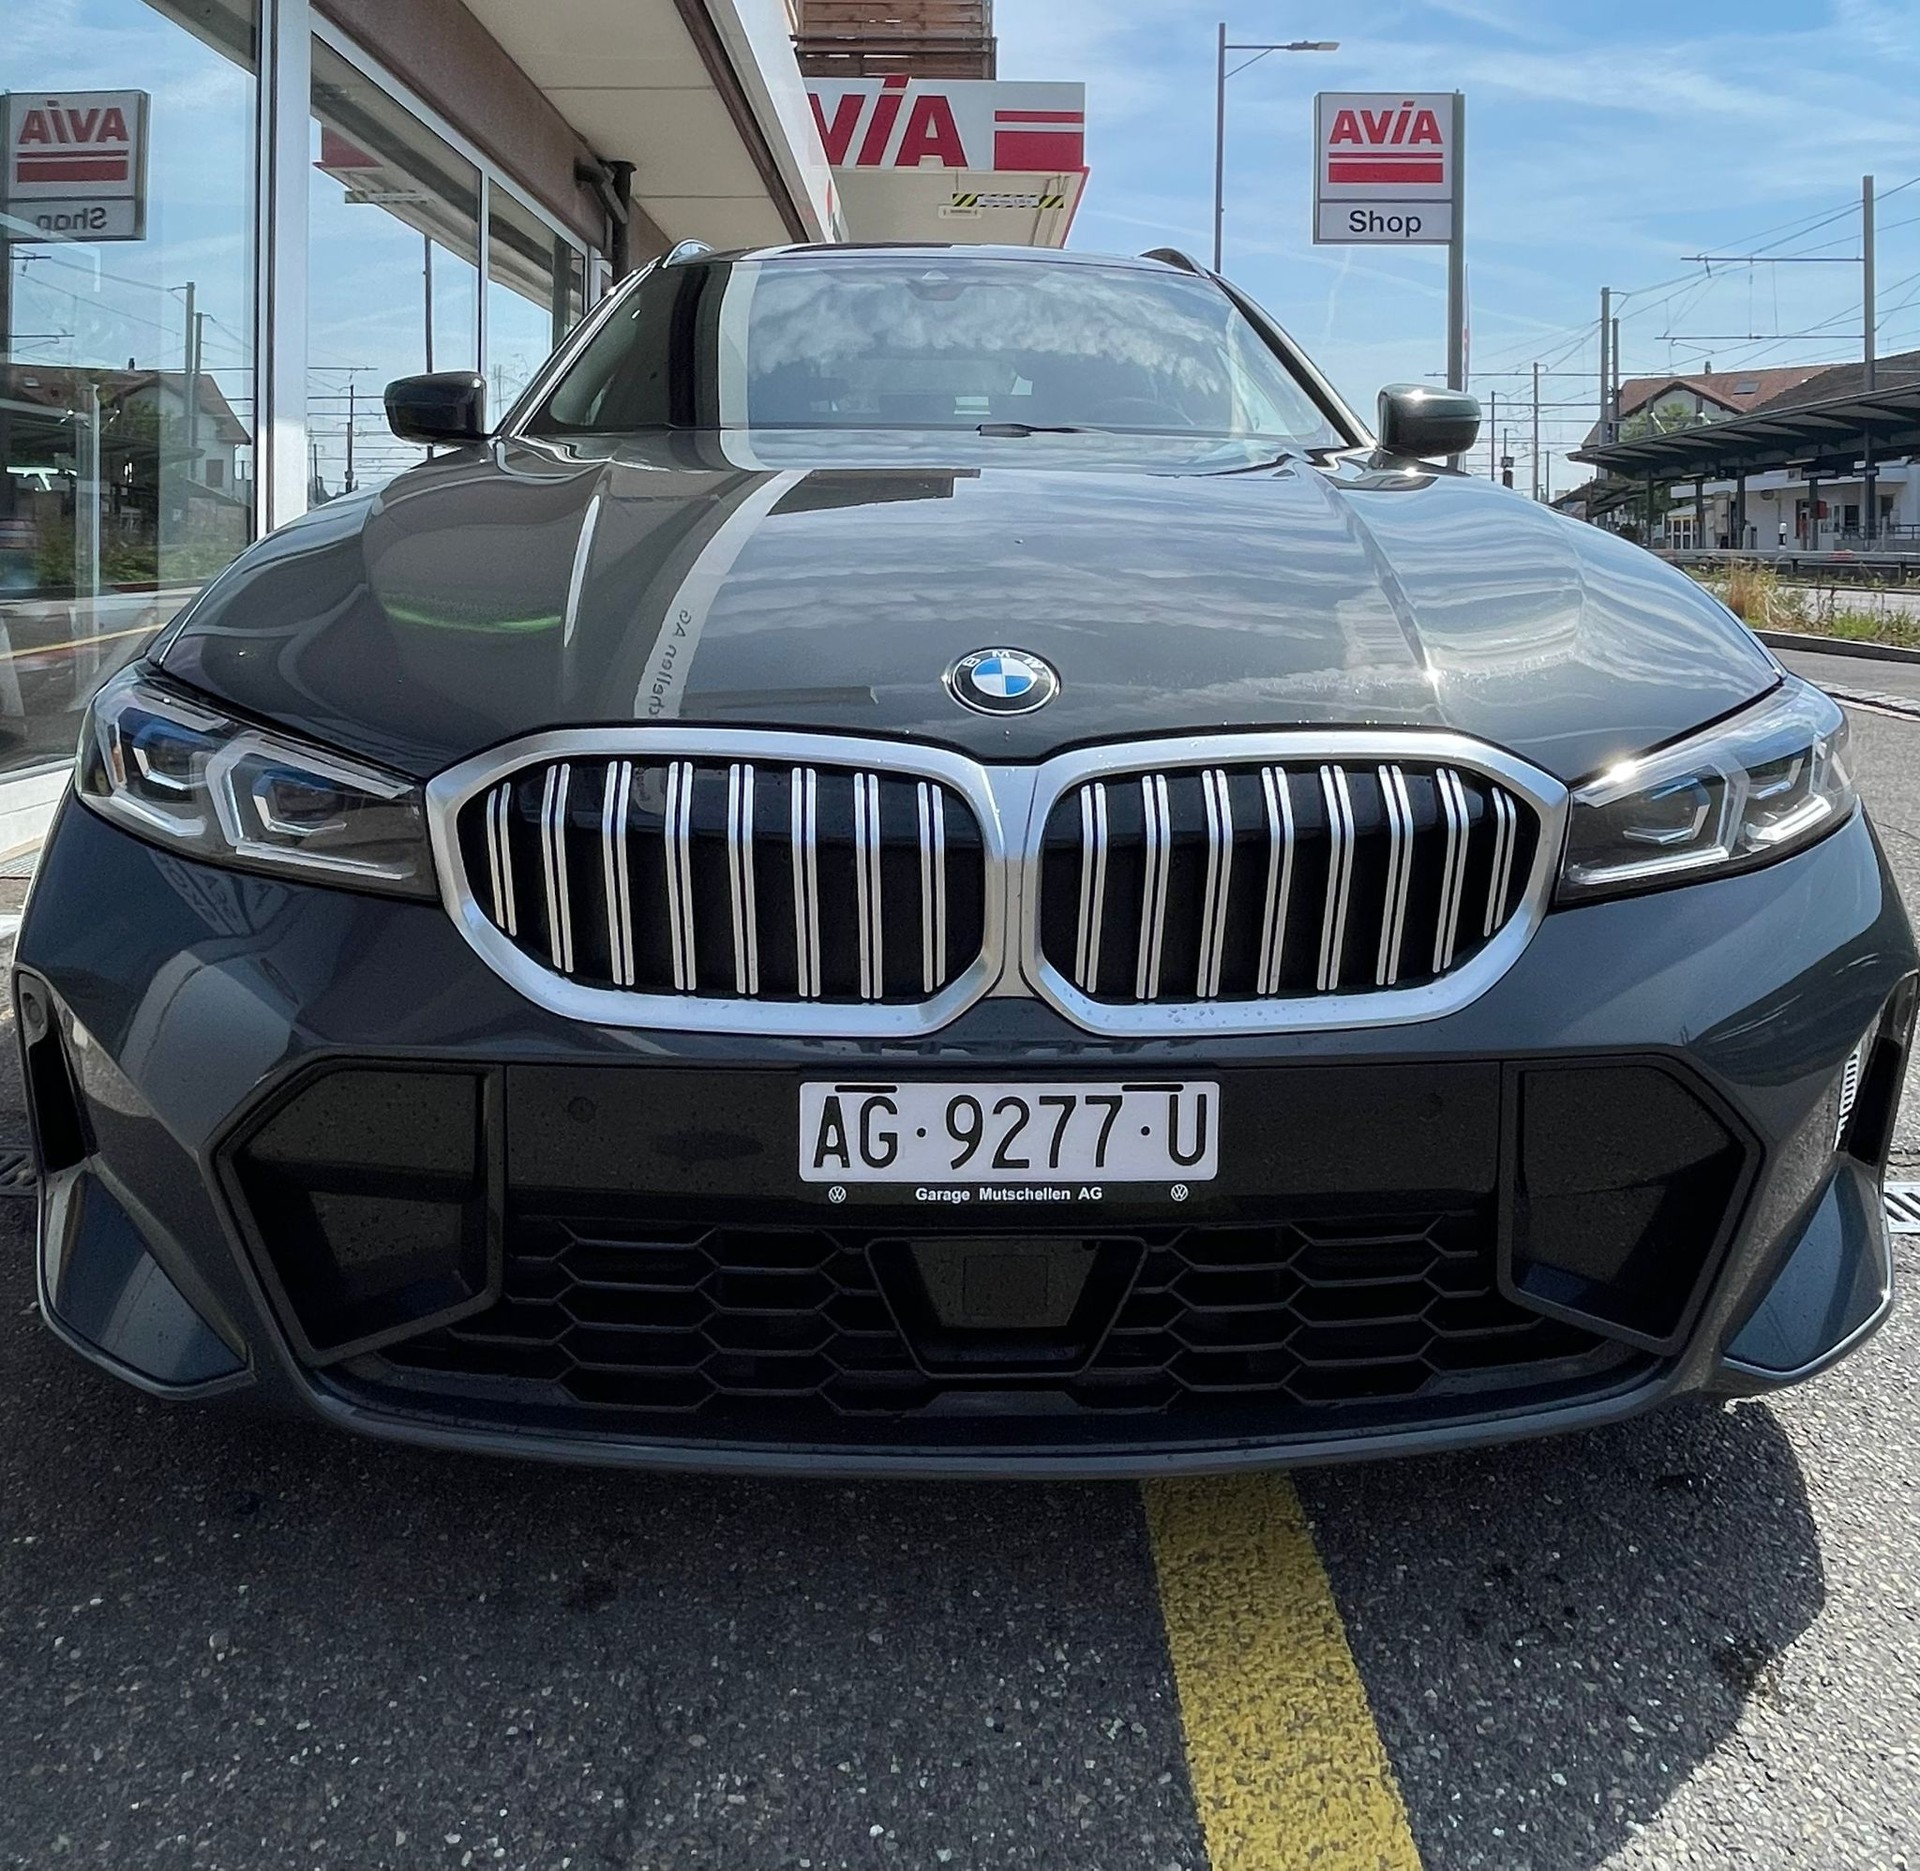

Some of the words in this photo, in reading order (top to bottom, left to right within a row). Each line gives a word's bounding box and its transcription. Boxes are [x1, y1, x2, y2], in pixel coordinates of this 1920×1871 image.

[1329, 100, 1443, 145] AVIA
[1348, 209, 1422, 238] Shop
[962, 650, 1045, 669] BMW
[915, 1187, 971, 1204] Garage
[979, 1186, 1071, 1201] Mutschellen
[1078, 1186, 1103, 1201] AG
